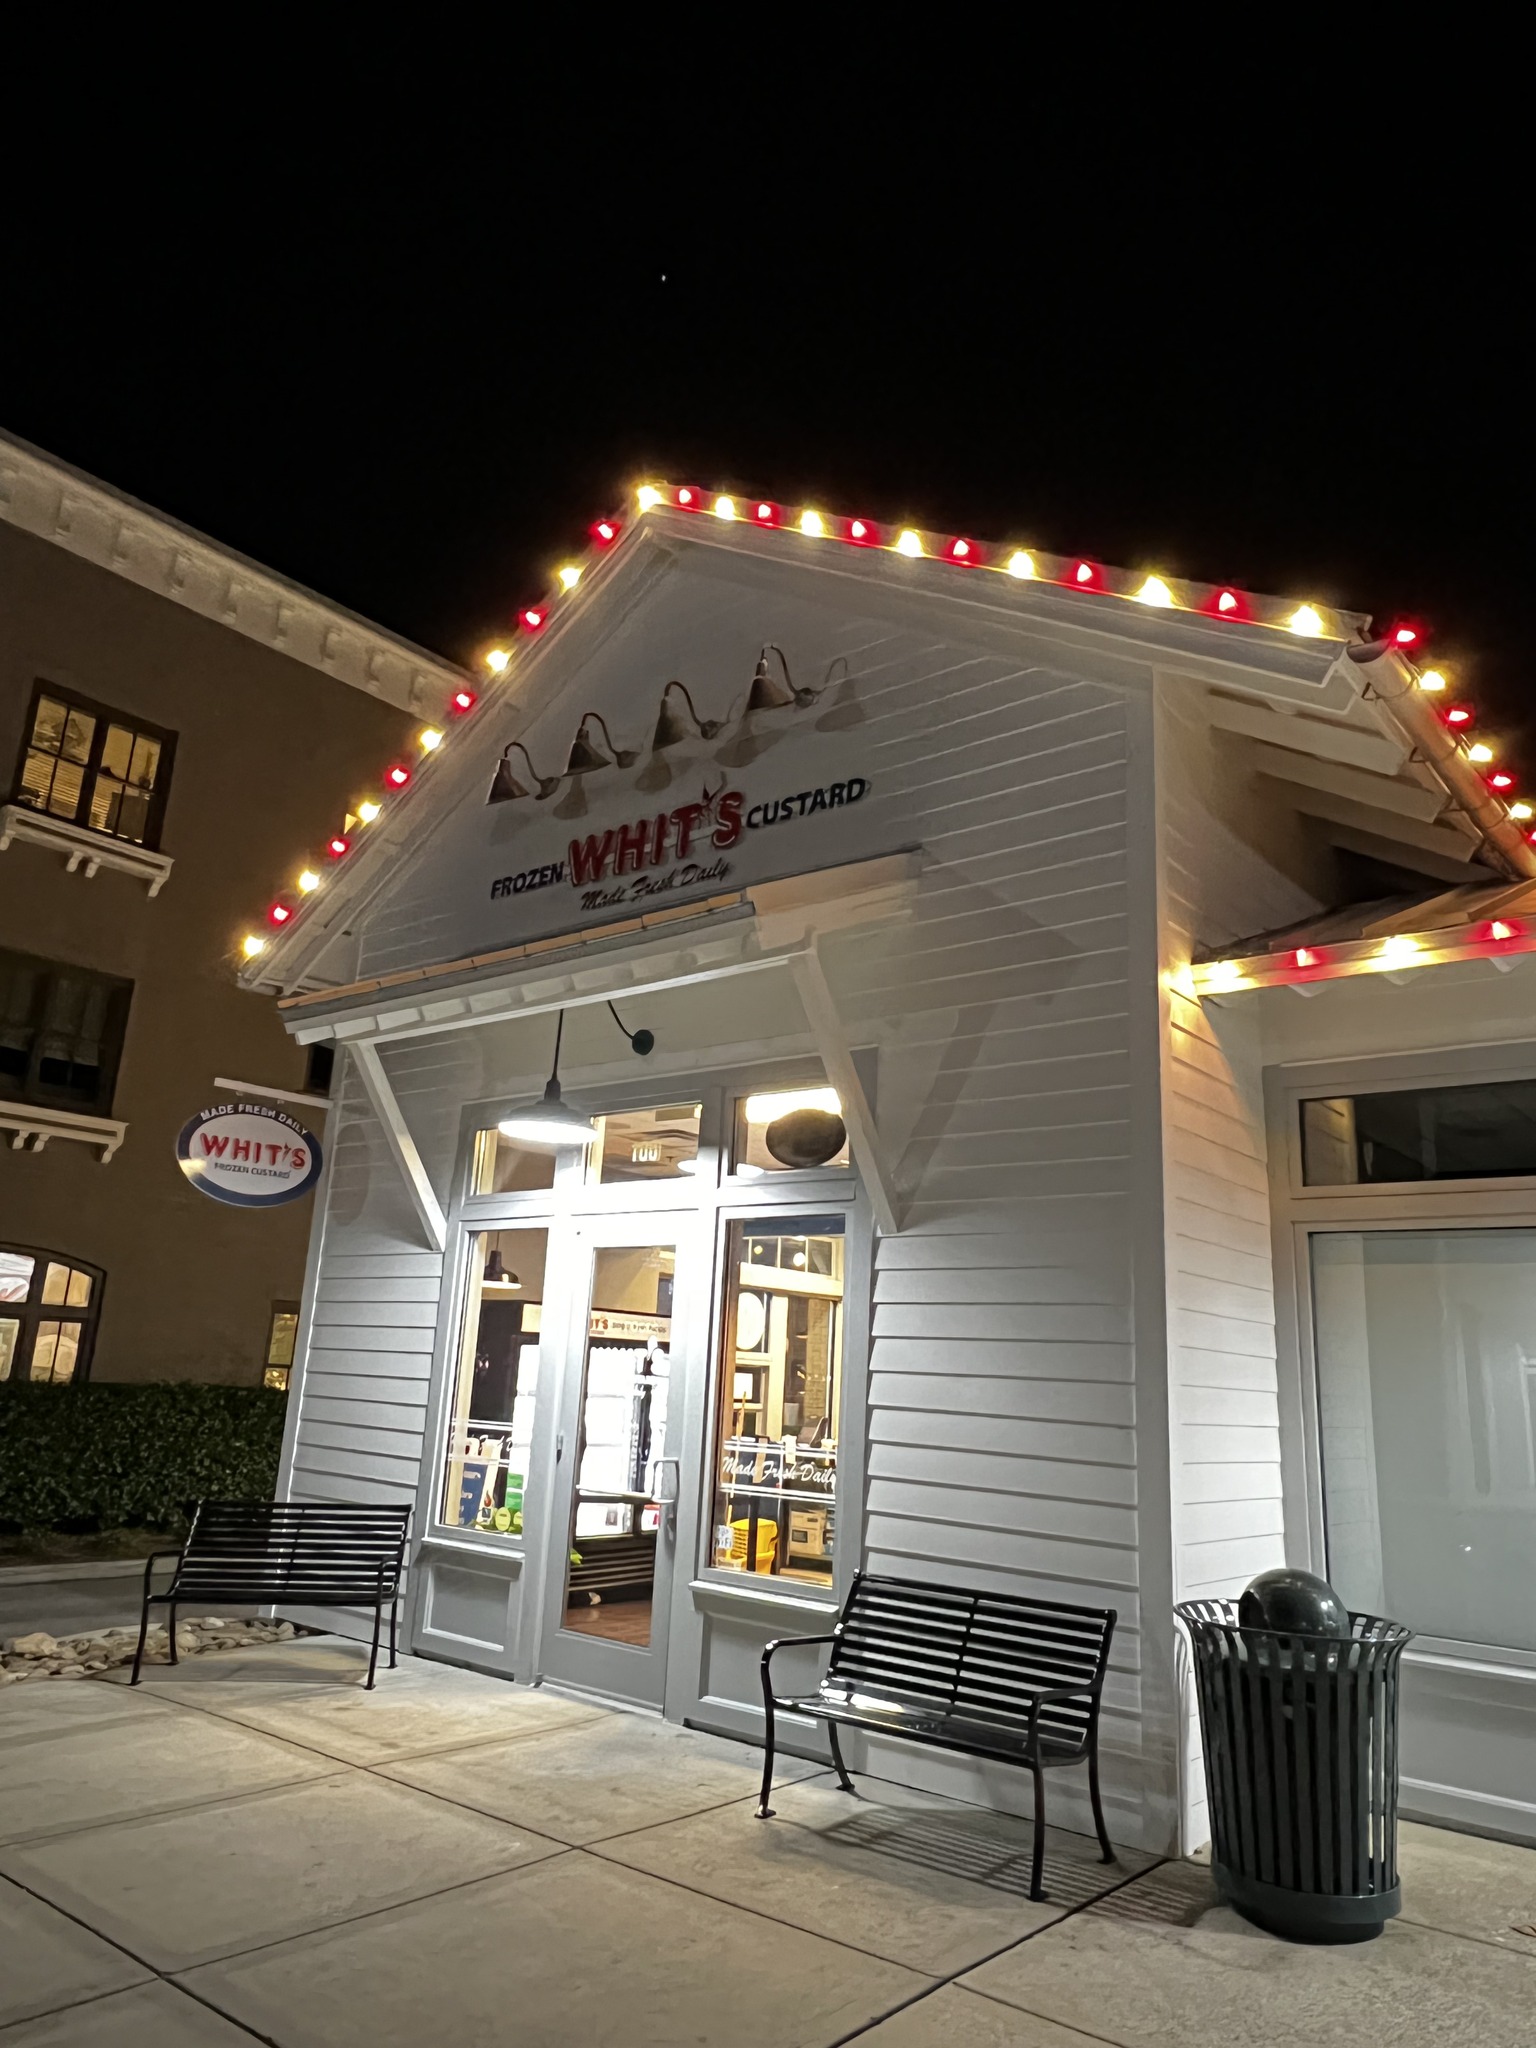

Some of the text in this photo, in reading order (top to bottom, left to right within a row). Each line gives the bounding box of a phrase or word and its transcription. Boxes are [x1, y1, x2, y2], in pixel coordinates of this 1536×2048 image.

[491, 778, 867, 899] FROZEN WHIT'S CUSTARD
[580, 885, 627, 911] Made
[679, 857, 731, 887] Daily
[200, 1104, 309, 1135] MADE FRESH DAILY
[200, 1133, 305, 1169] WHIT'S
[214, 1162, 290, 1179] FROZEN CUSTARD
